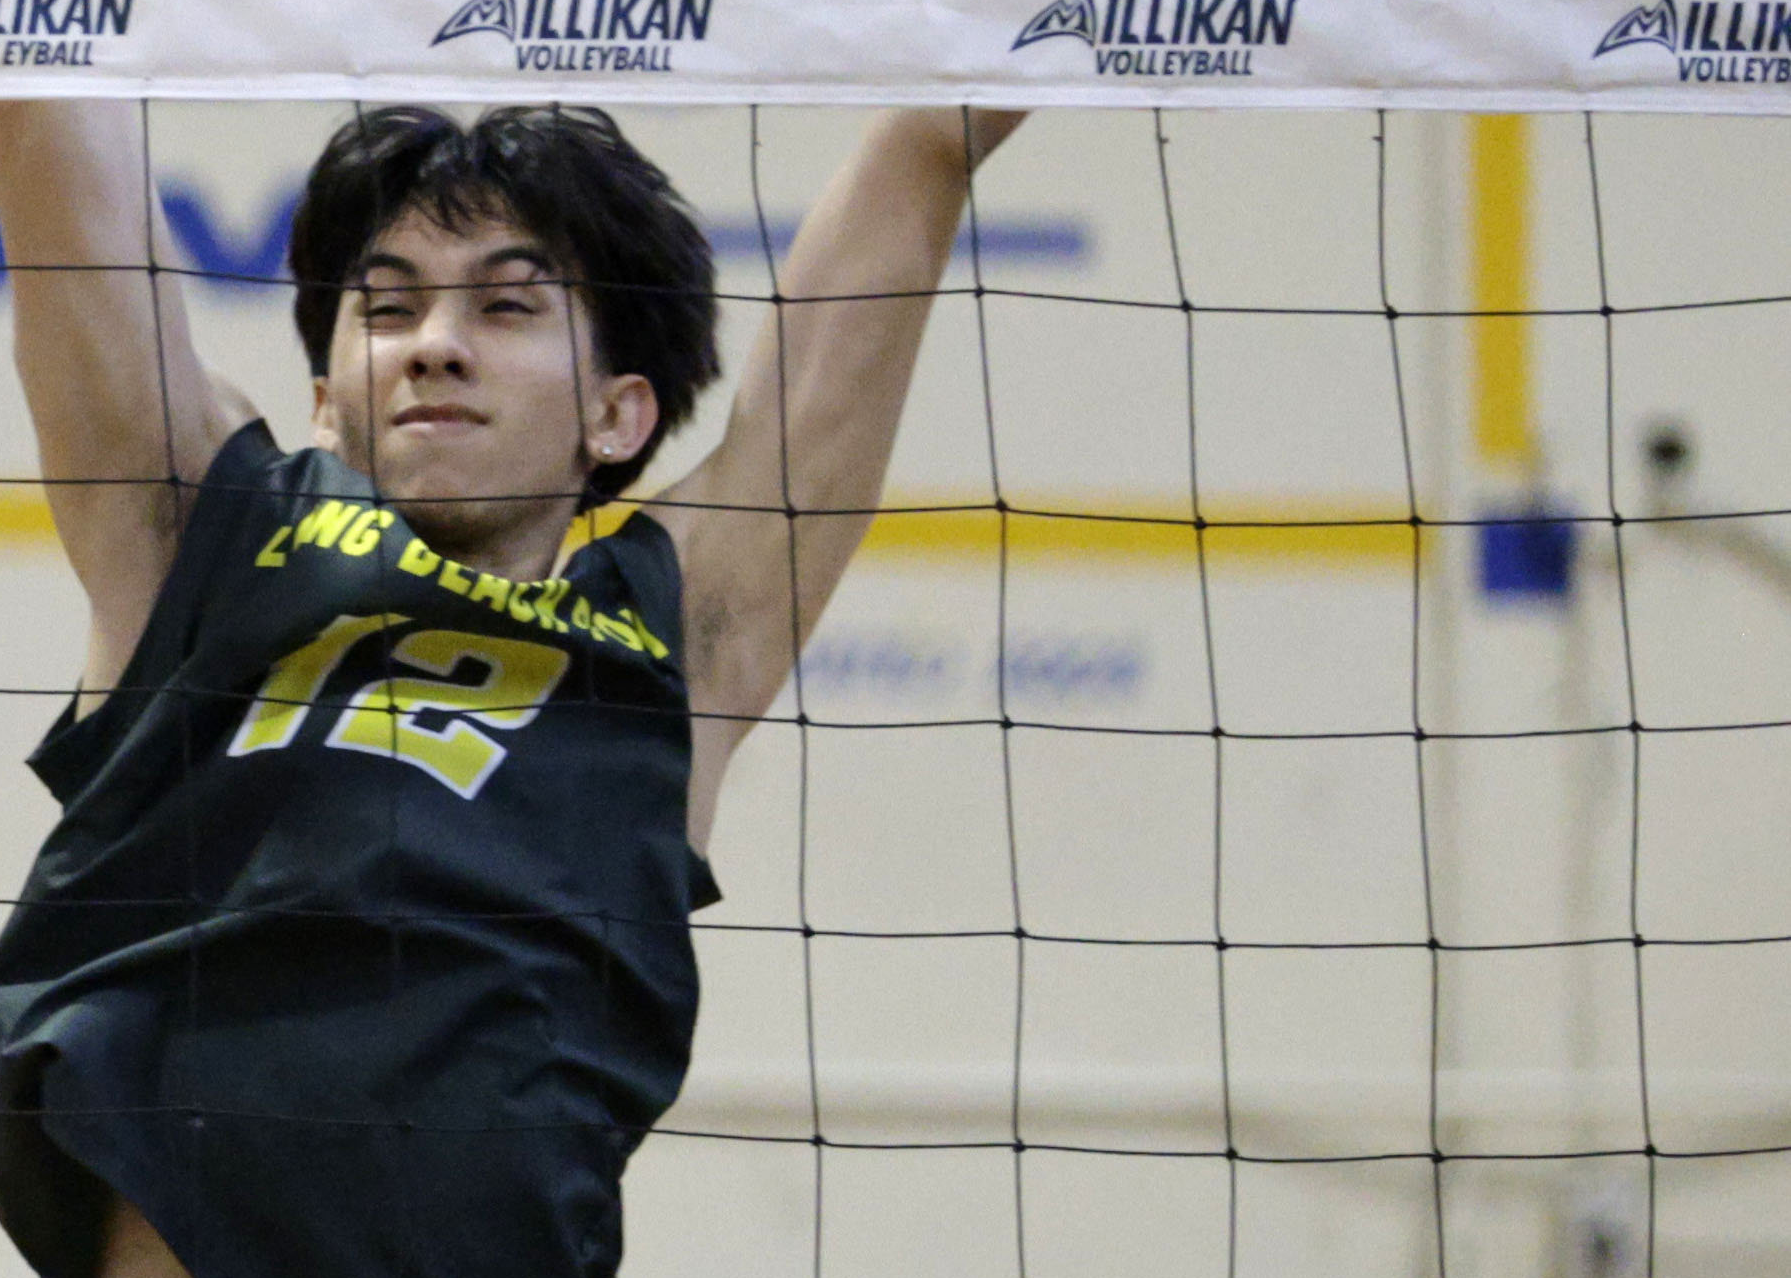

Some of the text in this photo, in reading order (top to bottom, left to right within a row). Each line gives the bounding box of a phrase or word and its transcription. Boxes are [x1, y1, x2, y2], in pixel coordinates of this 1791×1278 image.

[517, 45, 672, 72] VOLLEYBALL
[1096, 49, 1253, 76] VOLLEYBALL
[226, 611, 571, 801] 12
